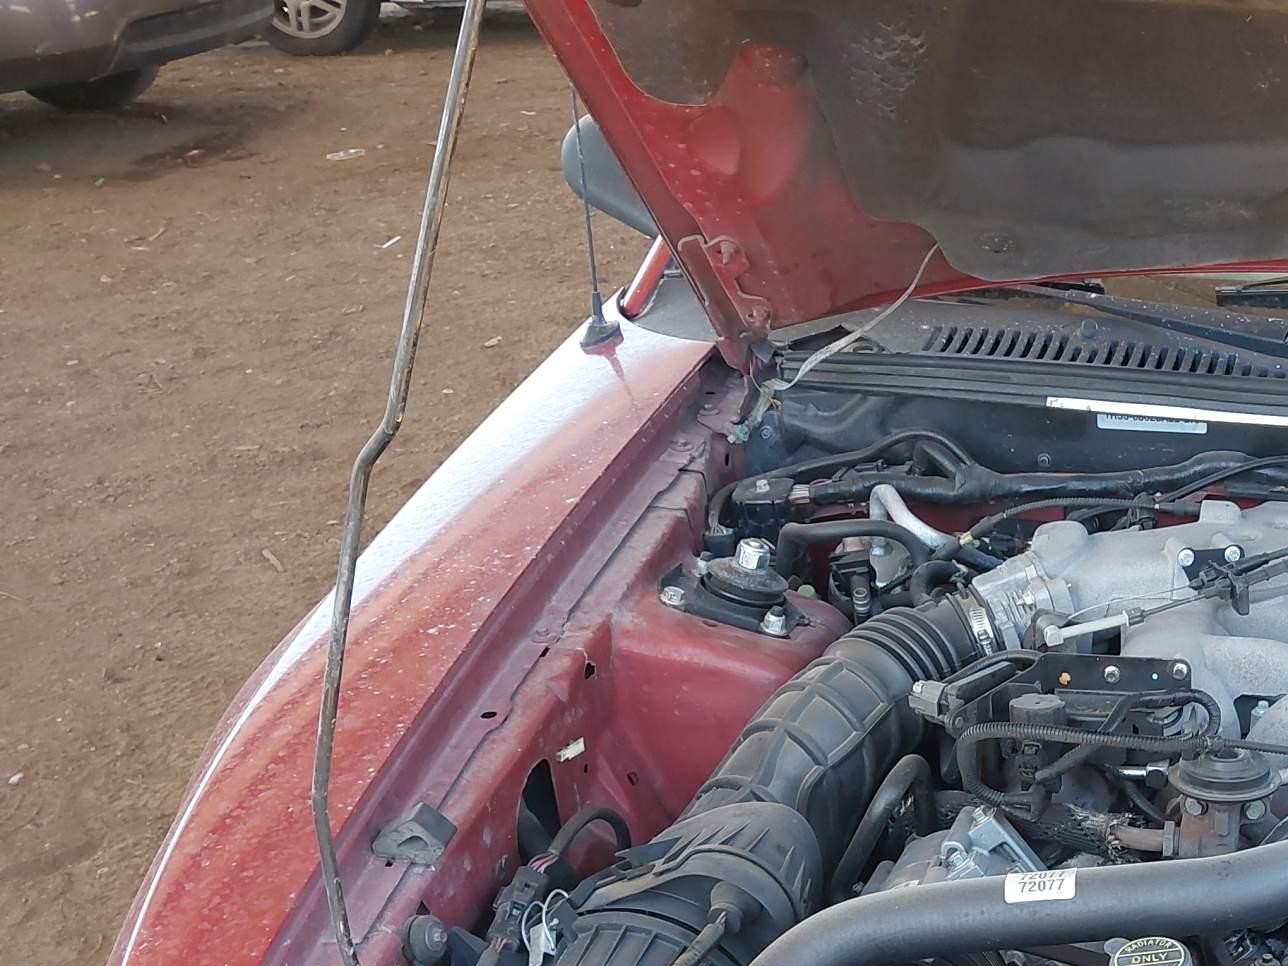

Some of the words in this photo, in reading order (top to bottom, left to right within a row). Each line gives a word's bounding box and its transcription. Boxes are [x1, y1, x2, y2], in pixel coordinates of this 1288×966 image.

[1018, 878, 1065, 893] 72077
[1125, 938, 1173, 953] RADIATOR
[1131, 952, 1168, 964] ONLY
